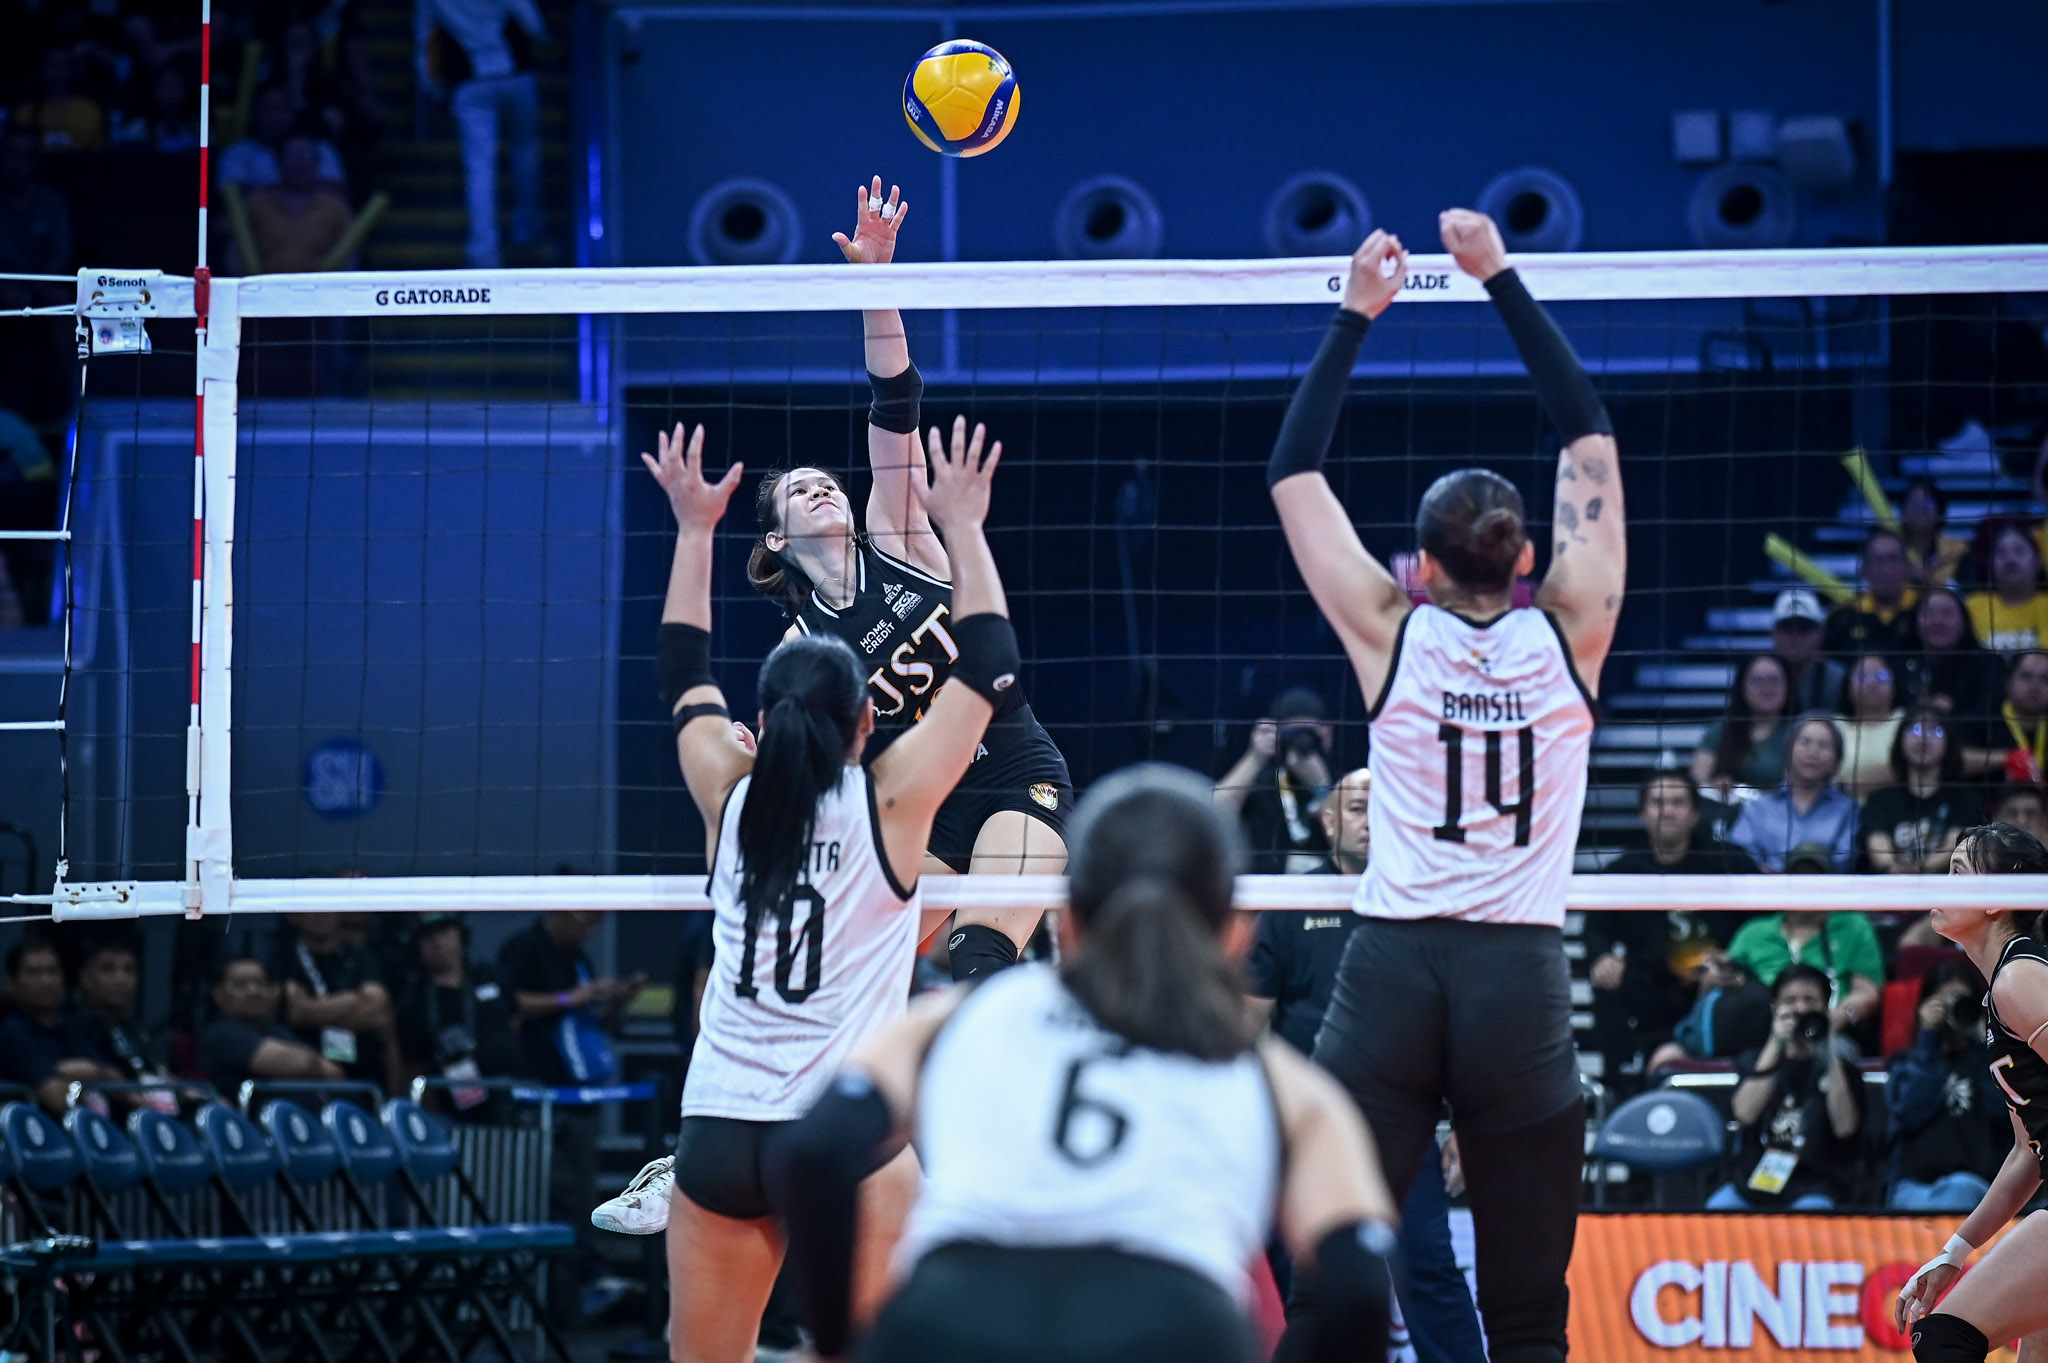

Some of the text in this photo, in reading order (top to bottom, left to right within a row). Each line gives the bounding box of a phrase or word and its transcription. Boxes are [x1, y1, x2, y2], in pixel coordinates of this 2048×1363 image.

[108, 277, 147, 287] Senoh
[394, 288, 491, 305] GATORADE
[884, 583, 904, 605] DELTA
[899, 594, 922, 620] STRONG
[860, 619, 888, 648] HOME
[866, 622, 896, 654] CREDIT
[1441, 691, 1527, 722] BANSIL
[1433, 722, 1535, 846] 14
[735, 884, 826, 1004] 10
[1054, 1056, 1129, 1172] 6
